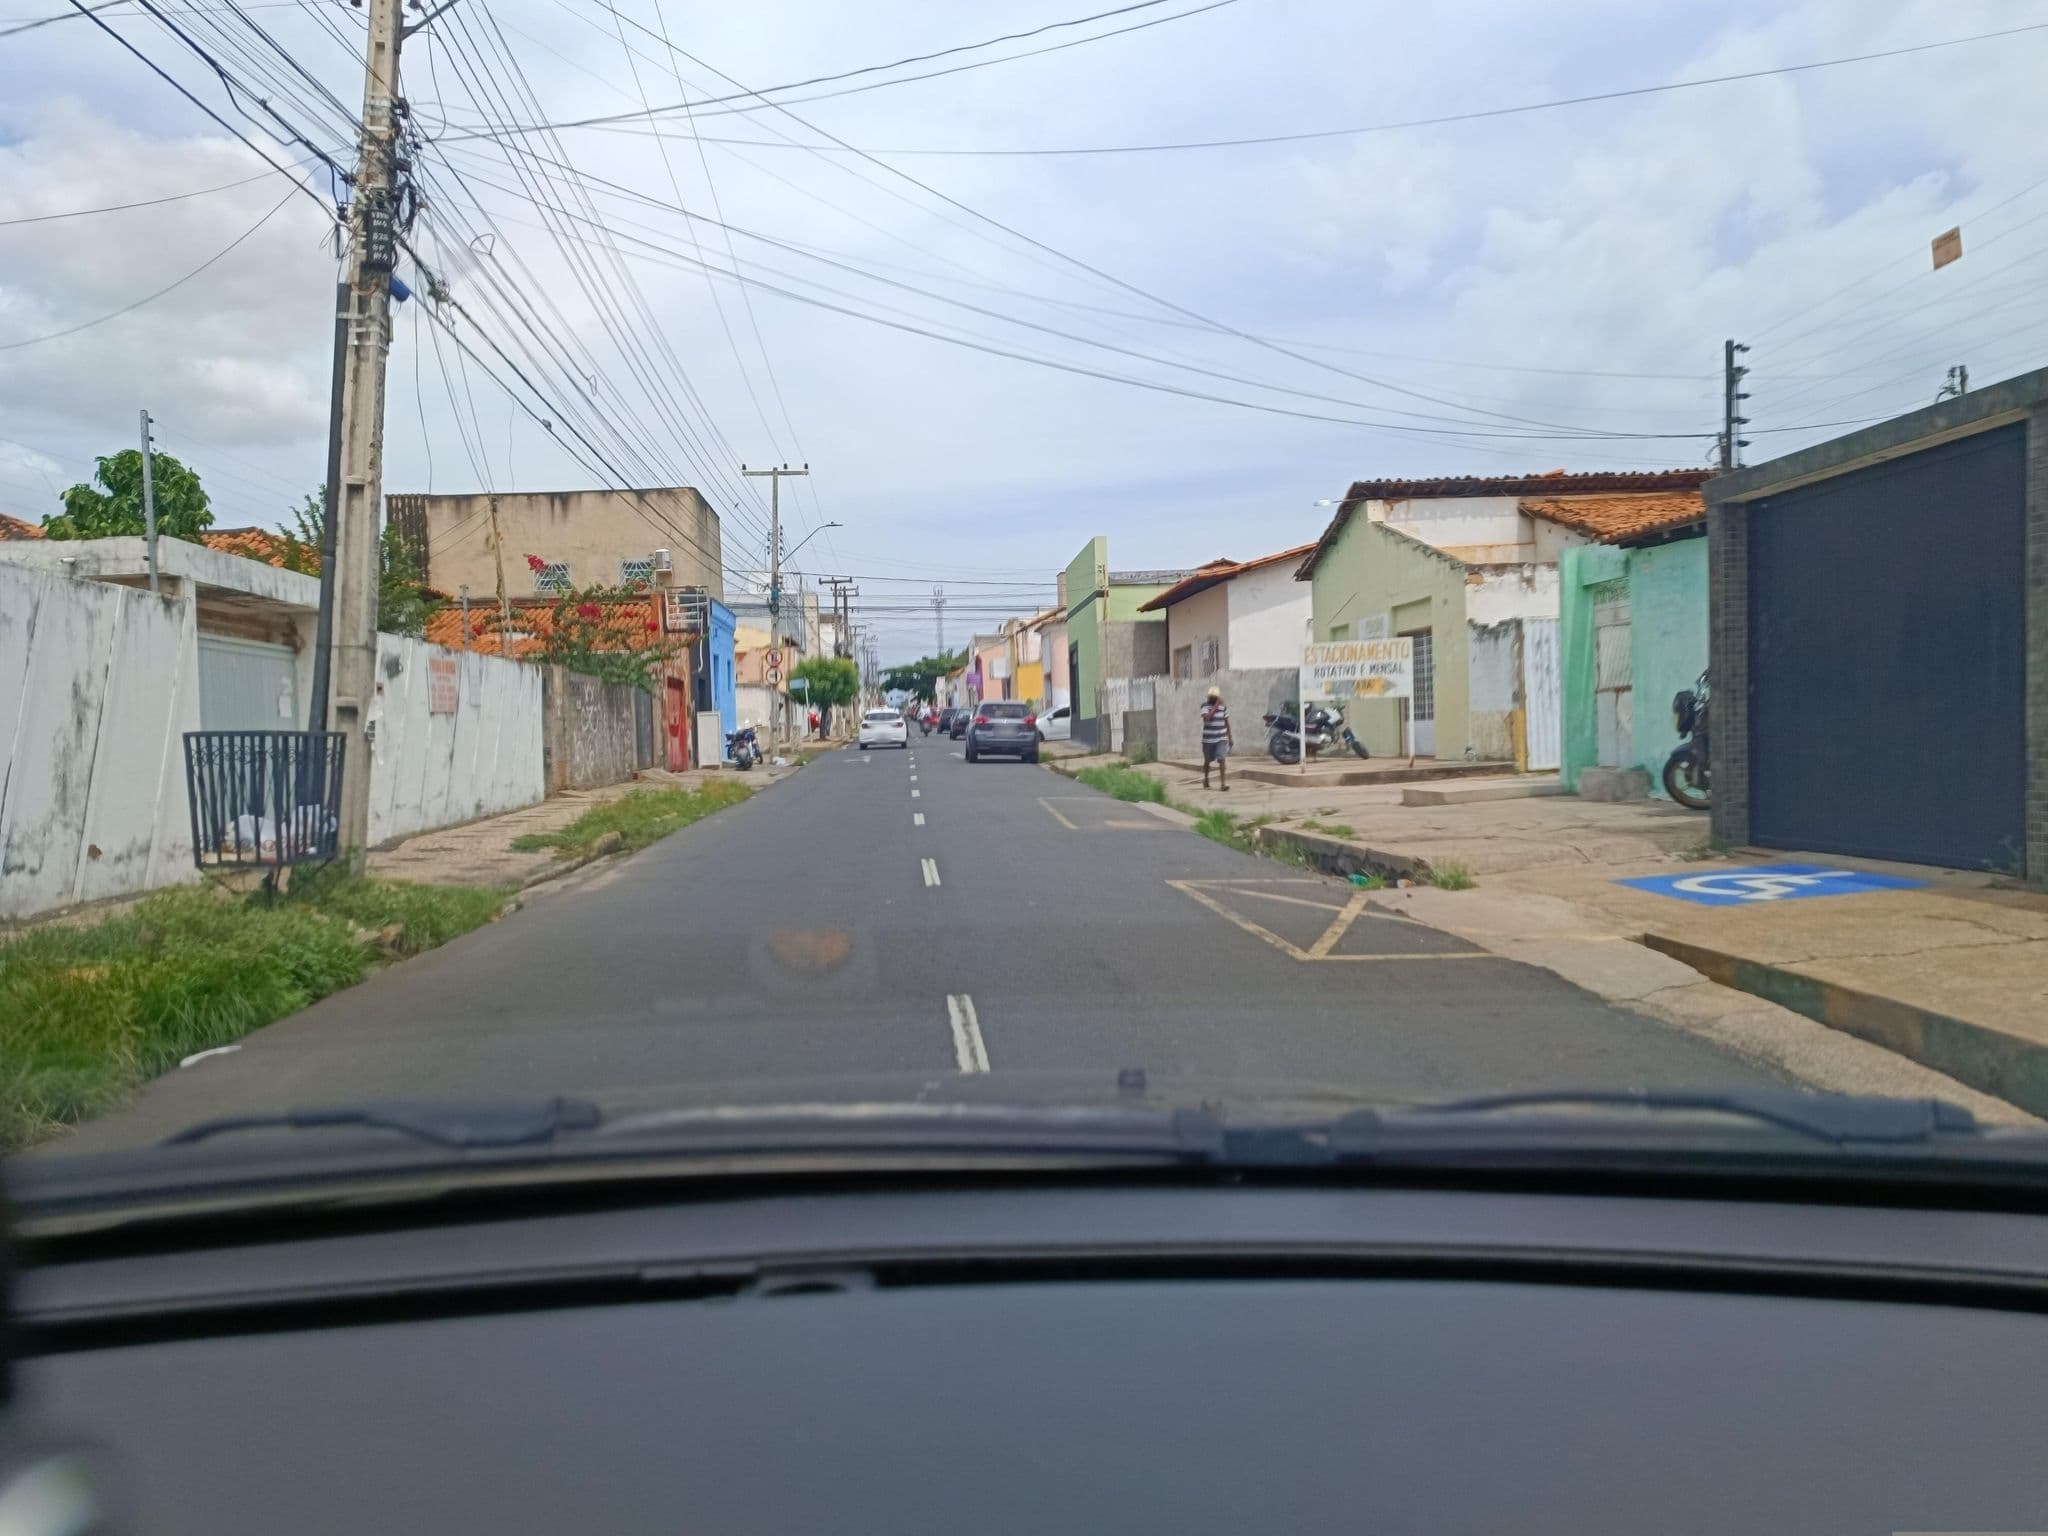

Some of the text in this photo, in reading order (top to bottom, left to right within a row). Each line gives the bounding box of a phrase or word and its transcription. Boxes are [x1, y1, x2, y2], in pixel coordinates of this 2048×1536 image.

[1304, 641, 1410, 665] ESTACIONAMENTO
[1314, 663, 1356, 679] ROTATIVO
[1369, 662, 1404, 676] MENSAL
